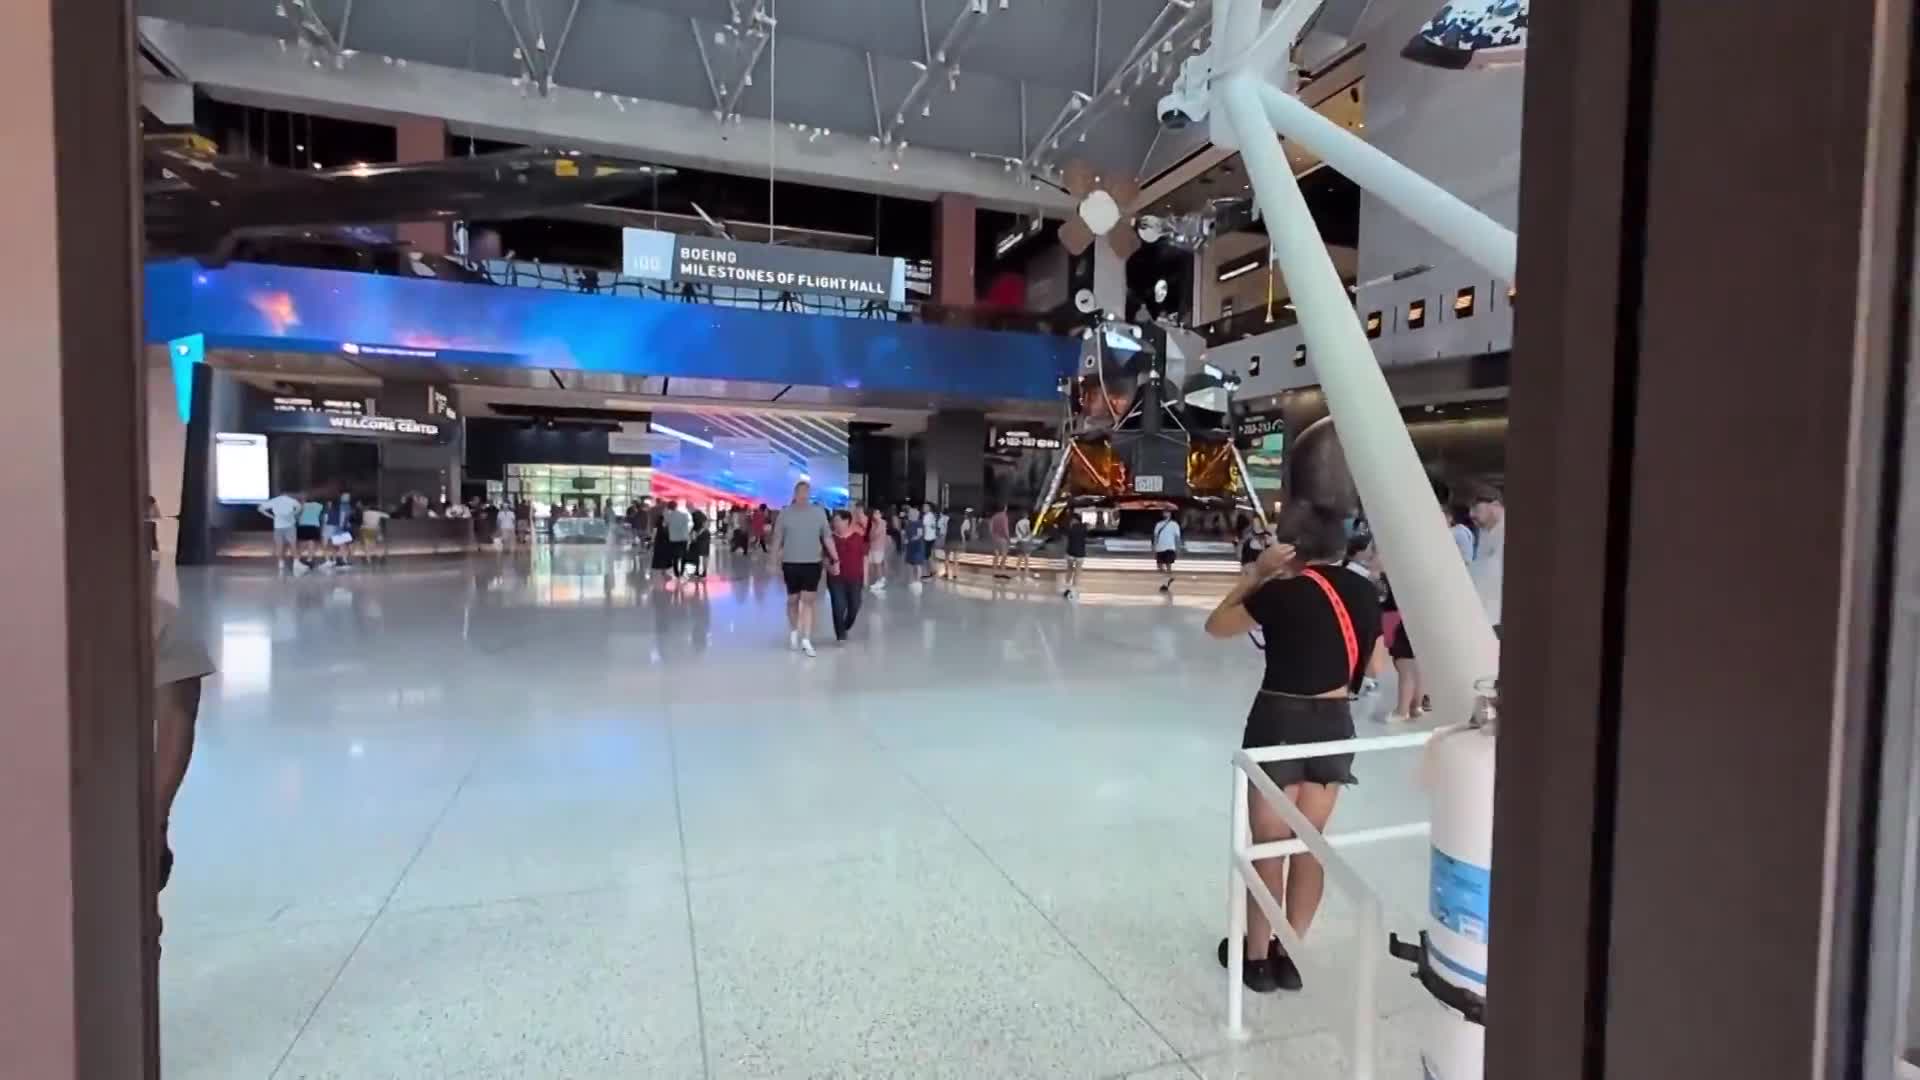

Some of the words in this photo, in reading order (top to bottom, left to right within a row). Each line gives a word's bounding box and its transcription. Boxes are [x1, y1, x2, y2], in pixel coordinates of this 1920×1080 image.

[680, 247, 737, 264] BOEING
[680, 263, 774, 283] MILESTONES
[777, 271, 795, 285] OF
[798, 274, 848, 290] FLIGHT
[849, 279, 885, 294] HALL
[329, 416, 396, 431] WELCOME
[399, 423, 439, 434] CENTER
